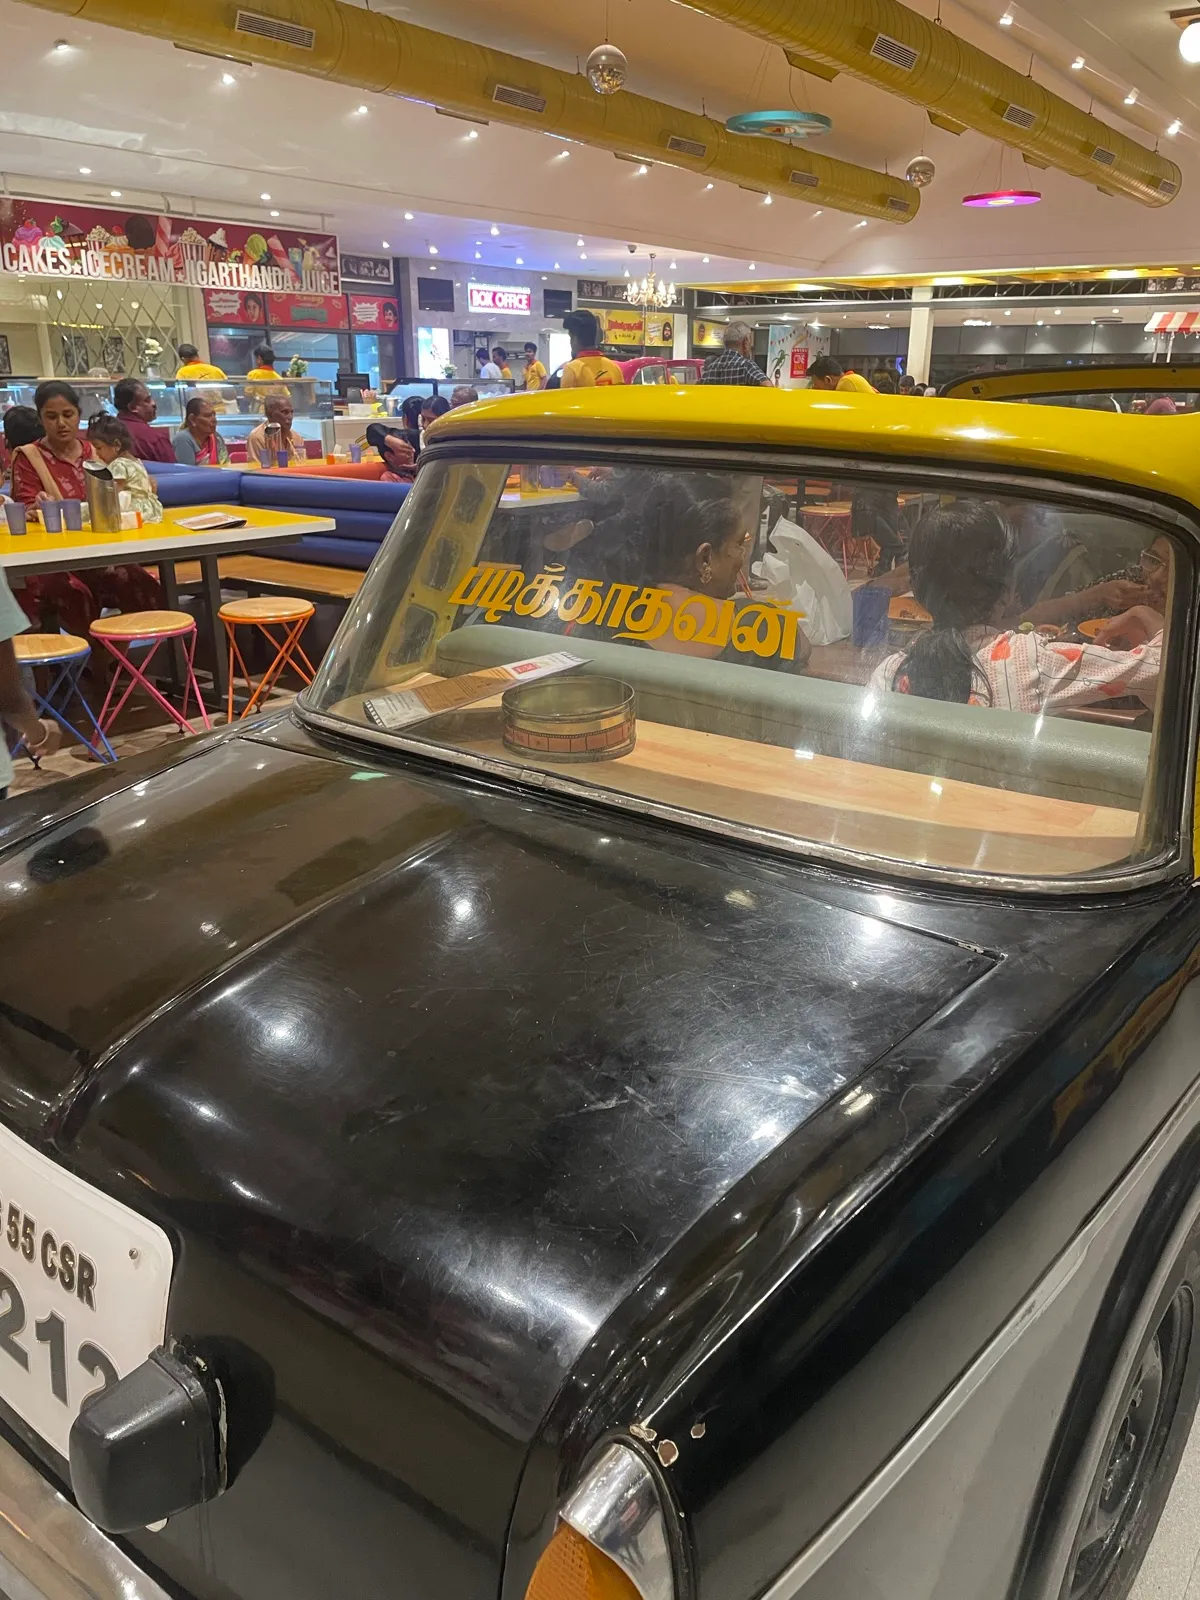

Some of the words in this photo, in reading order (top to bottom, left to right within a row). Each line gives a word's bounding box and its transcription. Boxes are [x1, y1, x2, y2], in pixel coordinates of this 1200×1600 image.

[3, 243, 73, 275] CAKES
[81, 249, 176, 282] ICECREAM
[184, 258, 295, 291] JIGARTHANDA
[300, 269, 338, 294] JUICE
[472, 289, 494, 307] BOX
[495, 291, 528, 310] OFFICE
[448, 563, 807, 660] படிக்காதவன்
